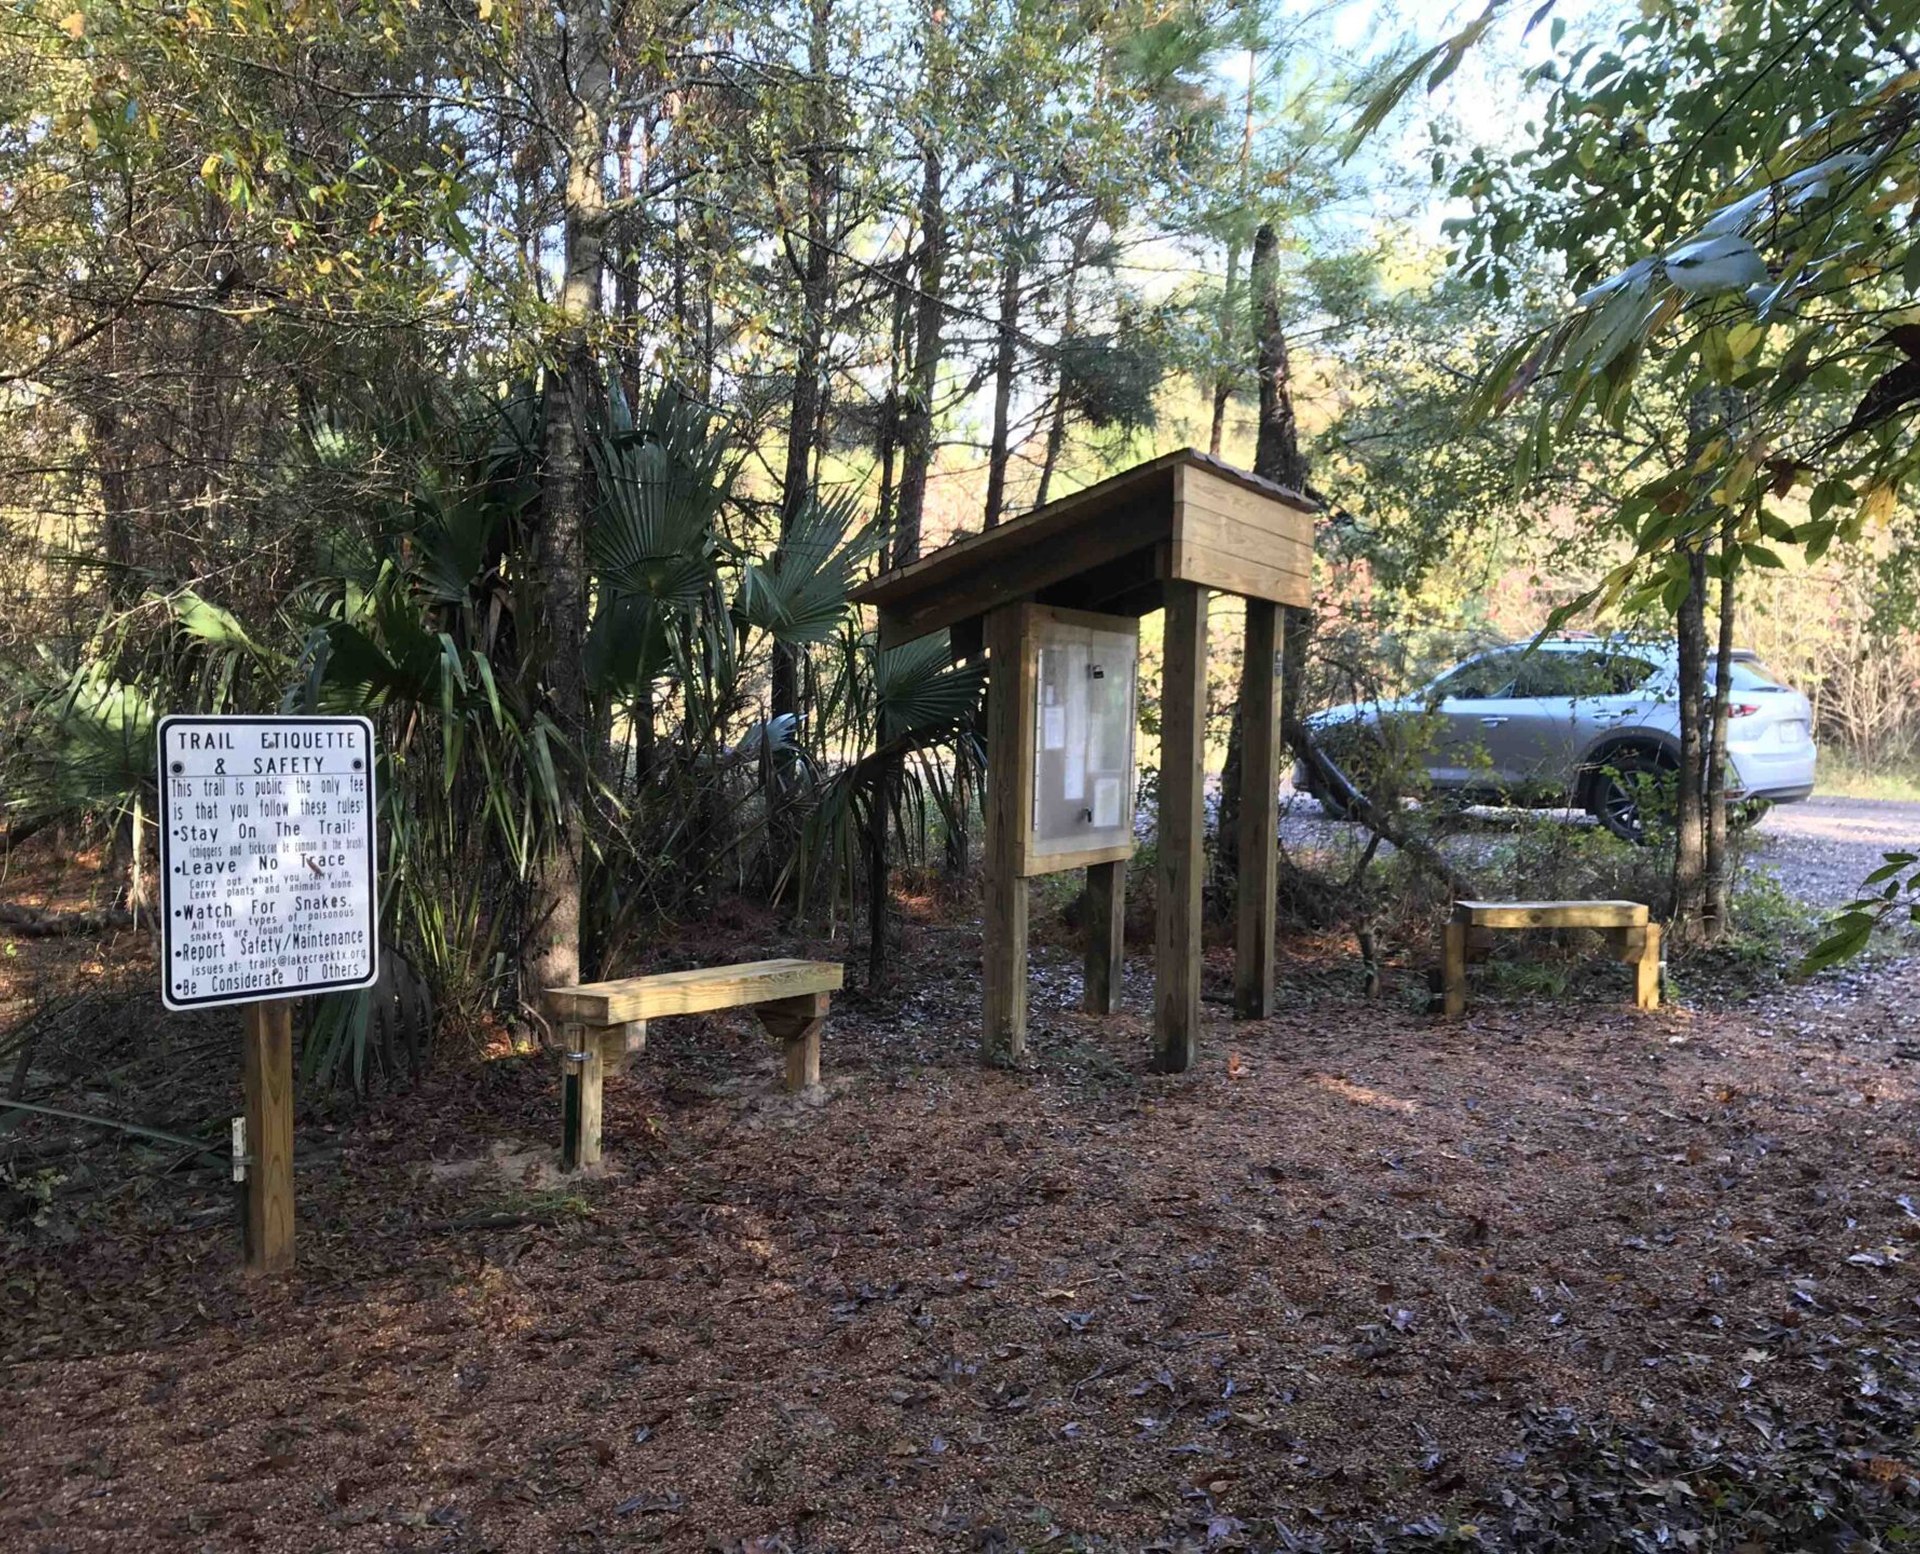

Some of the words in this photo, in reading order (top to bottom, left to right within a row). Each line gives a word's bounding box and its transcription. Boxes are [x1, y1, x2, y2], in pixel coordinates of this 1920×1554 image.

[178, 732, 235, 750] TRAIL
[261, 732, 355, 749] ETIQUETTE
[214, 758, 226, 774] &
[254, 757, 324, 774] SAFETY
[172, 779, 192, 798] This
[204, 779, 225, 797] trail
[236, 778, 244, 796] is
[296, 776, 311, 794] the
[321, 776, 340, 796] only
[350, 775, 364, 793] fee
[174, 802, 183, 821] is
[196, 802, 218, 820] that
[230, 803, 248, 822] you
[260, 799, 289, 818] follow
[301, 797, 327, 816] these
[239, 823, 256, 839] On
[275, 821, 301, 837] The
[259, 855, 278, 871] No
[300, 853, 346, 869] Trace
[189, 879, 216, 890] Carry
[226, 877, 241, 886] out
[252, 874, 274, 884] what
[284, 874, 300, 884] you
[189, 890, 217, 900] Leave
[226, 886, 255, 898] plants
[265, 884, 280, 895] and
[289, 881, 322, 892] animals
[251, 899, 276, 916] For
[191, 920, 204, 932] All
[216, 918, 237, 929] four
[248, 914, 278, 928] types
[288, 912, 298, 923] of
[308, 909, 355, 922] poisonous
[190, 931, 223, 942] snakes
[234, 928, 249, 938] are
[259, 924, 284, 936] found
[240, 930, 364, 956] Safety/Maintenance
[191, 964, 224, 976] issues
[212, 968, 284, 993] Considerate
[297, 965, 309, 983] Of
